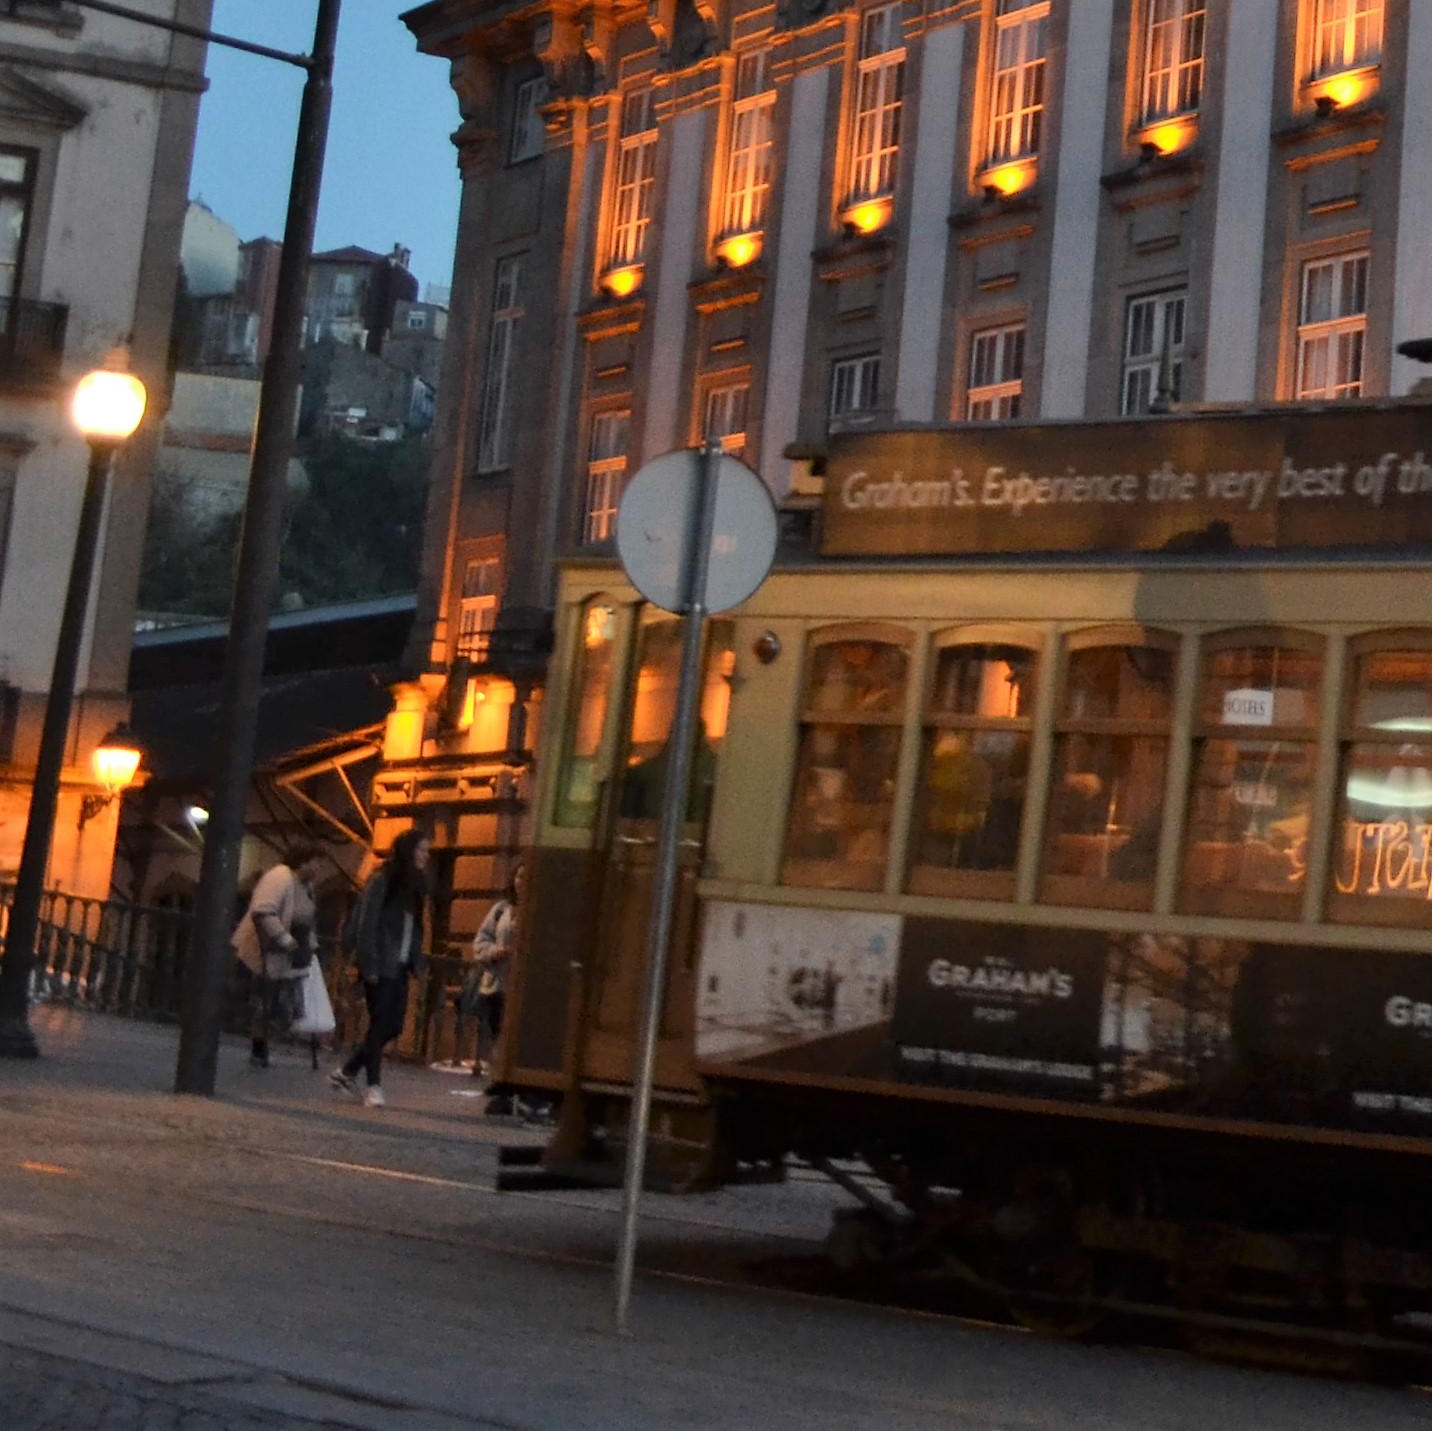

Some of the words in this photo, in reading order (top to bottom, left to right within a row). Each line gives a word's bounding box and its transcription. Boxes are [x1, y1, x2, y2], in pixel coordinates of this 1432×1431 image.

[981, 466, 1140, 517] Experience
[1146, 461, 1196, 501] the
[1207, 469, 1271, 511] very
[1278, 455, 1347, 498] best
[1354, 451, 1399, 506] of
[927, 957, 1074, 1000] GRAHAM'S
